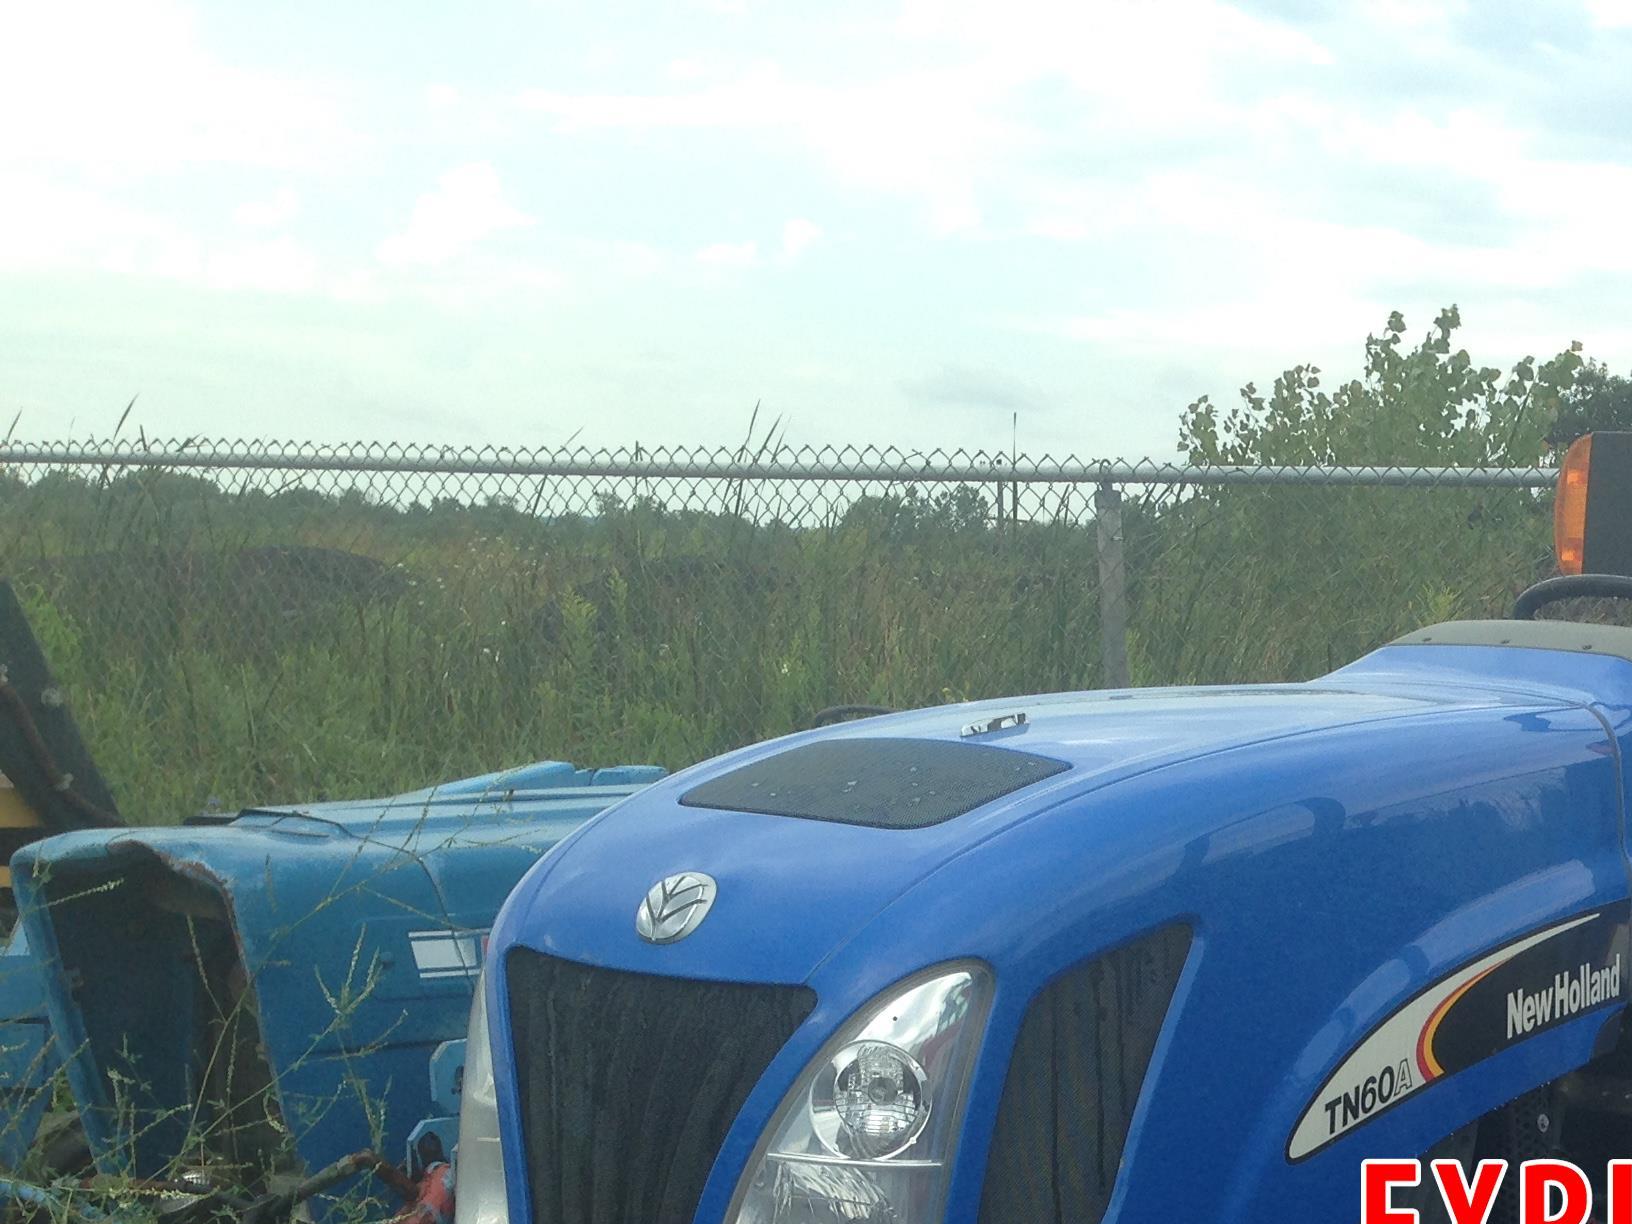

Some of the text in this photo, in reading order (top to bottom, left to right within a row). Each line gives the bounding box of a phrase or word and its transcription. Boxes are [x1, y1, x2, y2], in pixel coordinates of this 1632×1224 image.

[1507, 953, 1620, 1040] New Holland
[1325, 1058, 1413, 1136] TN60A
